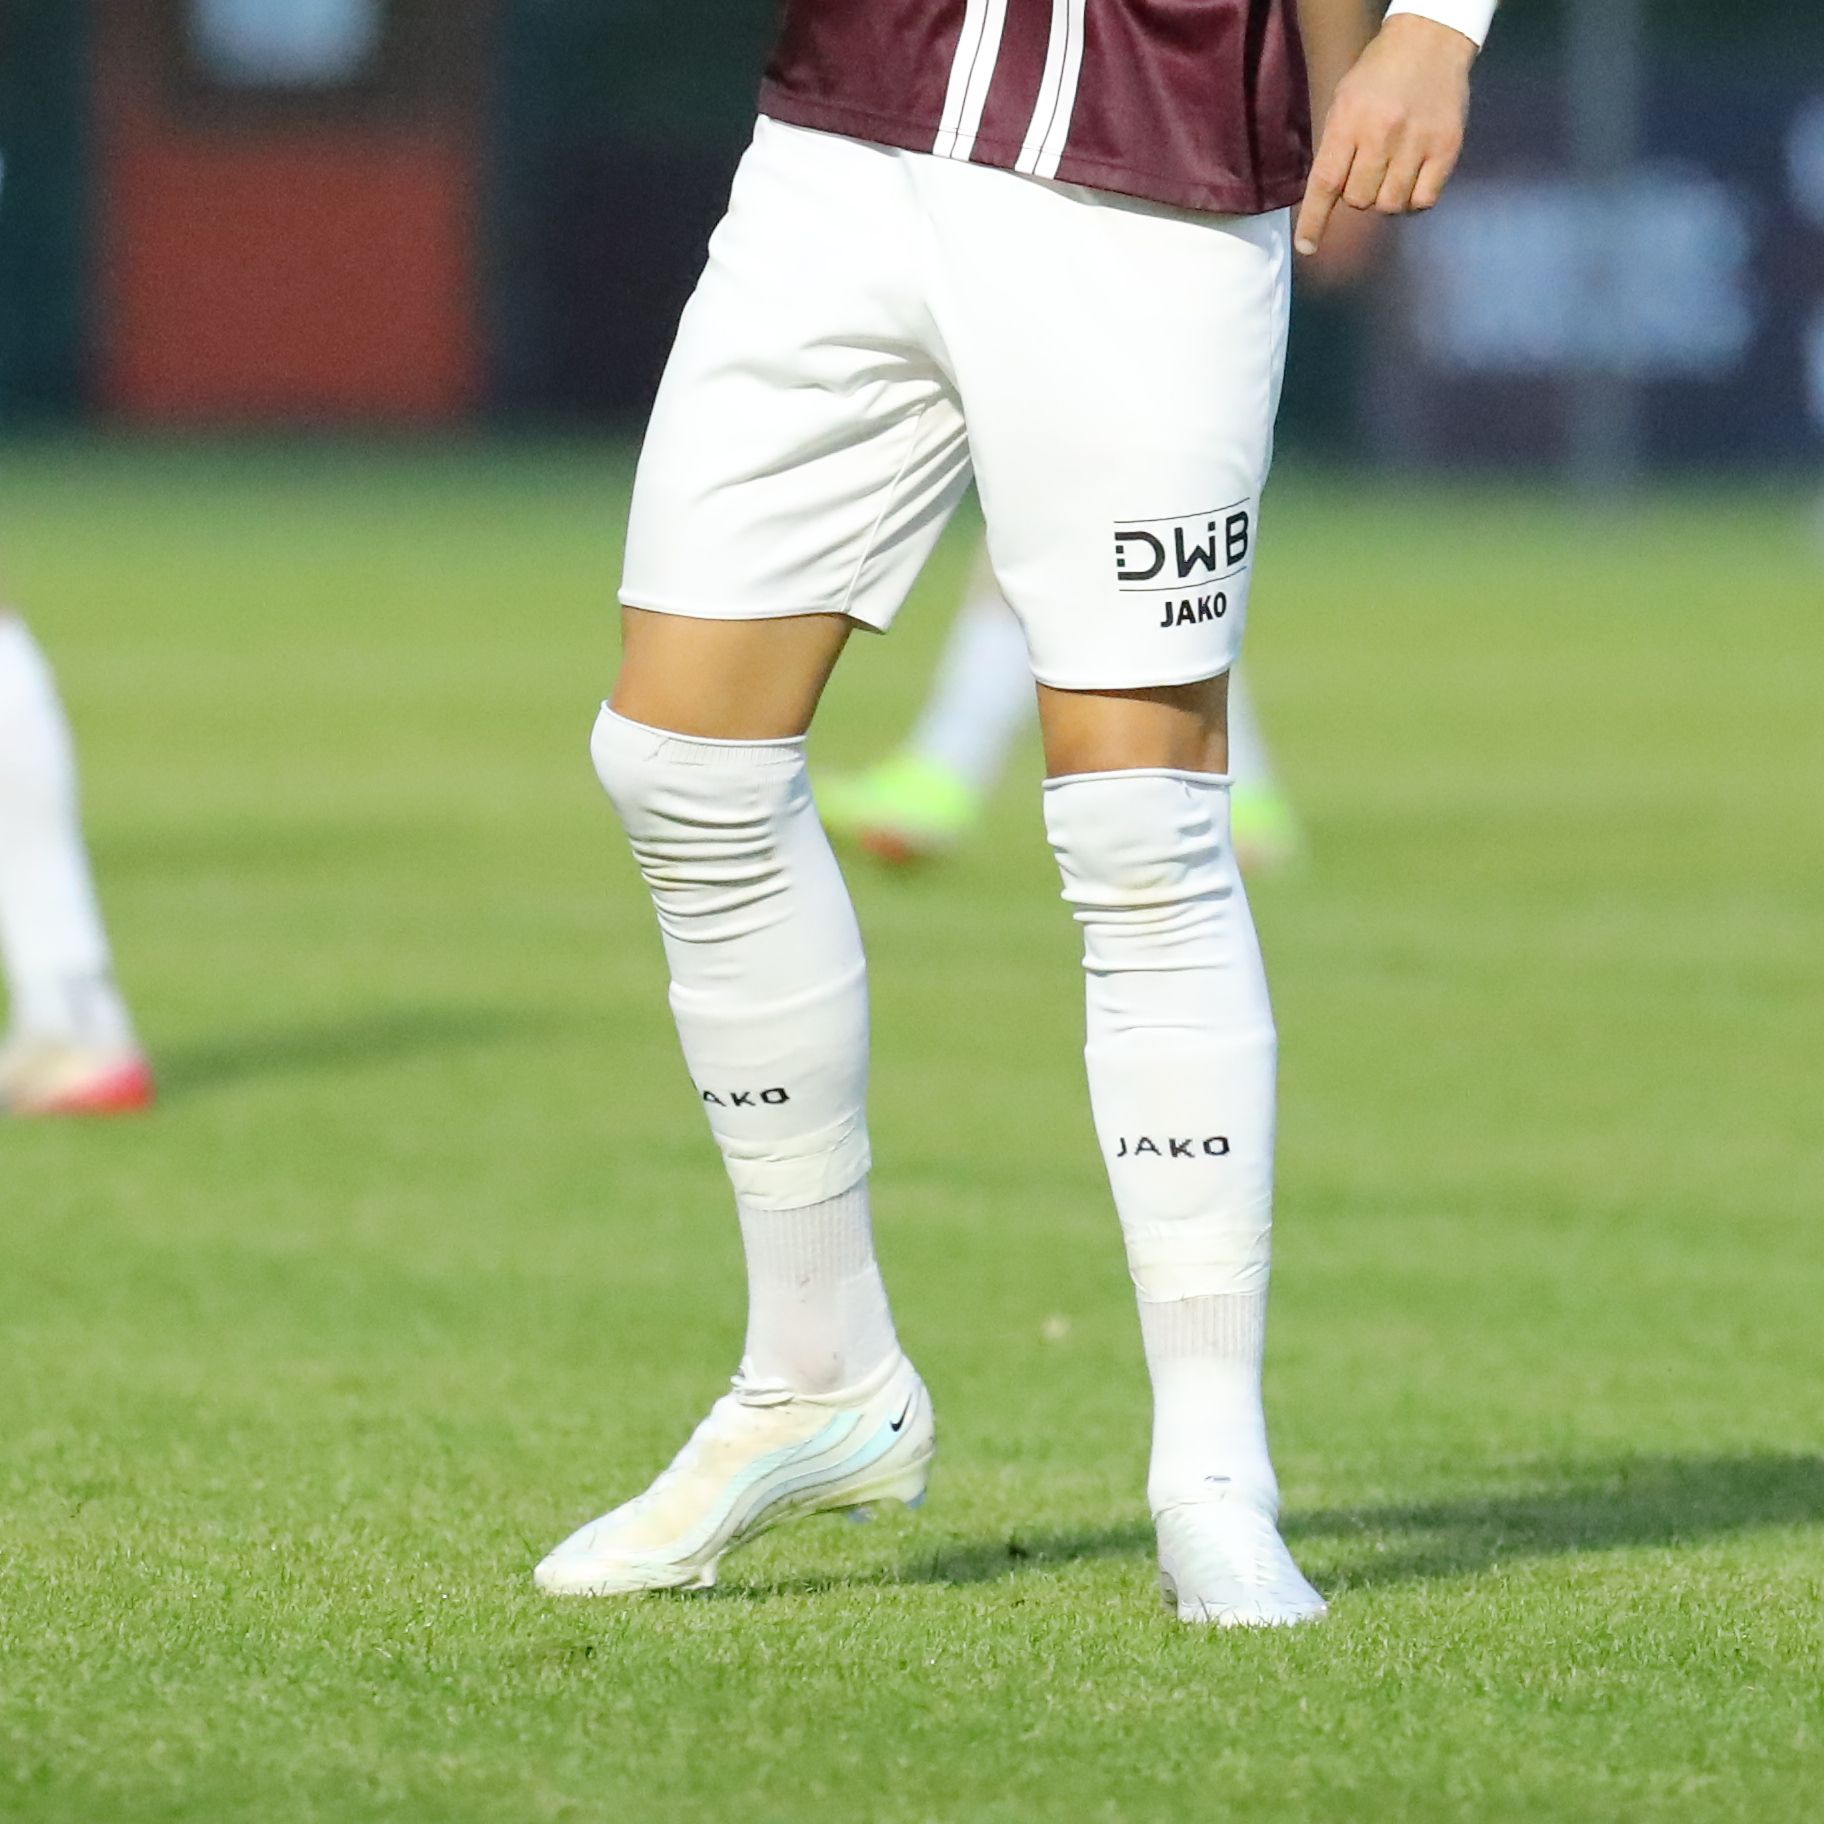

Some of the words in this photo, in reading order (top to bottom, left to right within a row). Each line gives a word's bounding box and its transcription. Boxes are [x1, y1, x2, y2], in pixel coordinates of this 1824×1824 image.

[1160, 591, 1227, 628] JAKO
[694, 1084, 790, 1107] AKO
[1116, 1136, 1230, 1158] JAKO
